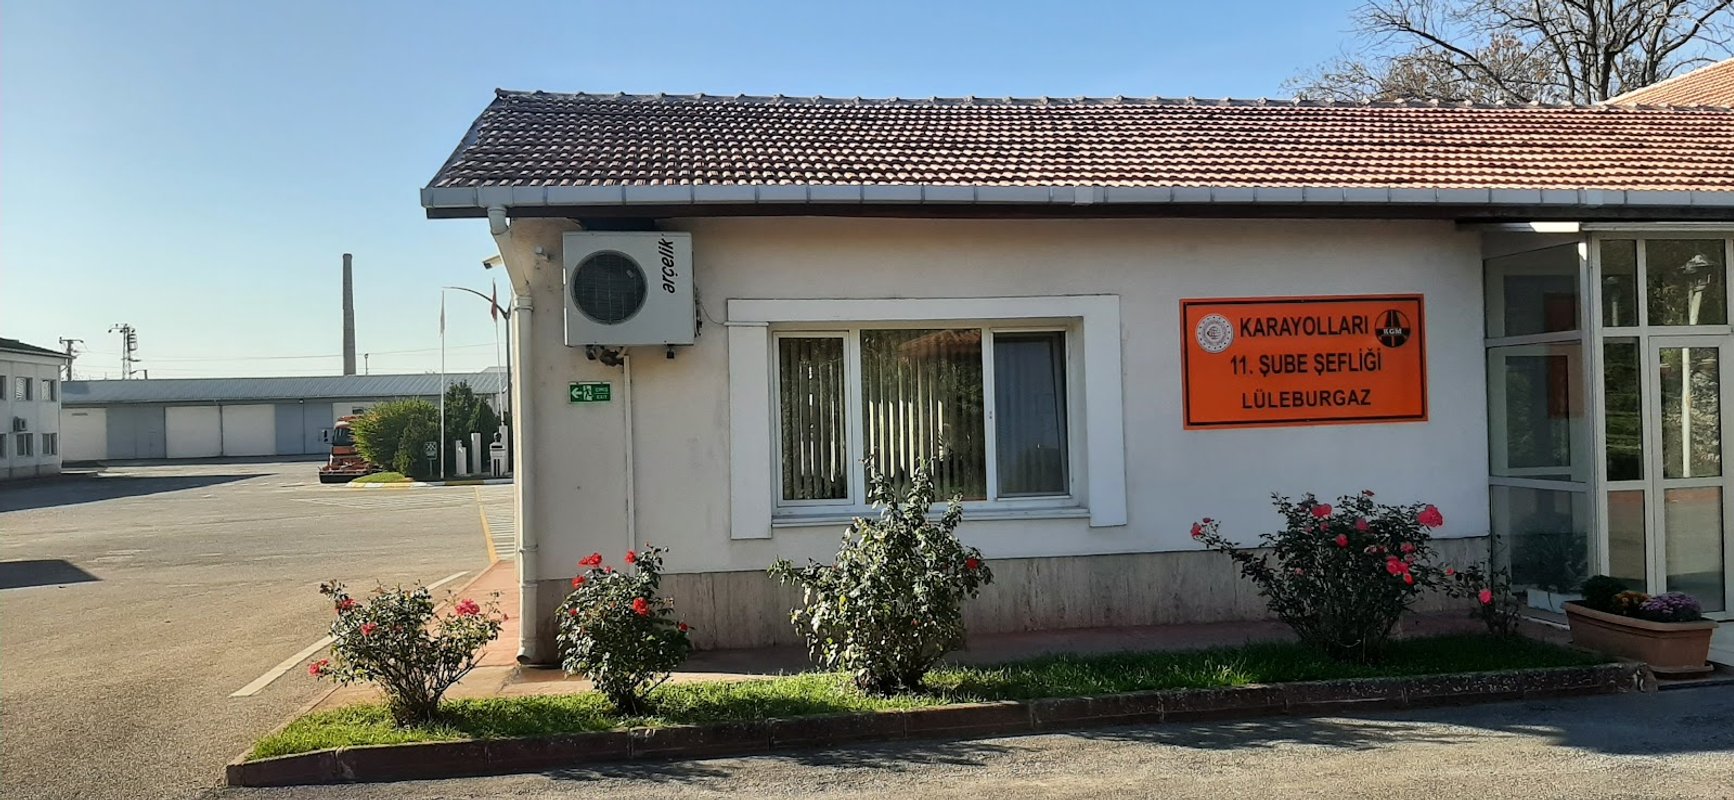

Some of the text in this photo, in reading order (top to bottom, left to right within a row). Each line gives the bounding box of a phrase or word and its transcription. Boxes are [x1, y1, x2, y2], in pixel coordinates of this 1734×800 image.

[658, 238, 678, 294] arçelik
[1240, 315, 1369, 337] KARAYOLLARI
[1230, 348, 1382, 377] 11. ŞUBE ŞEFLİĞİ
[1242, 389, 1371, 409] LÜLEBURGAZ
